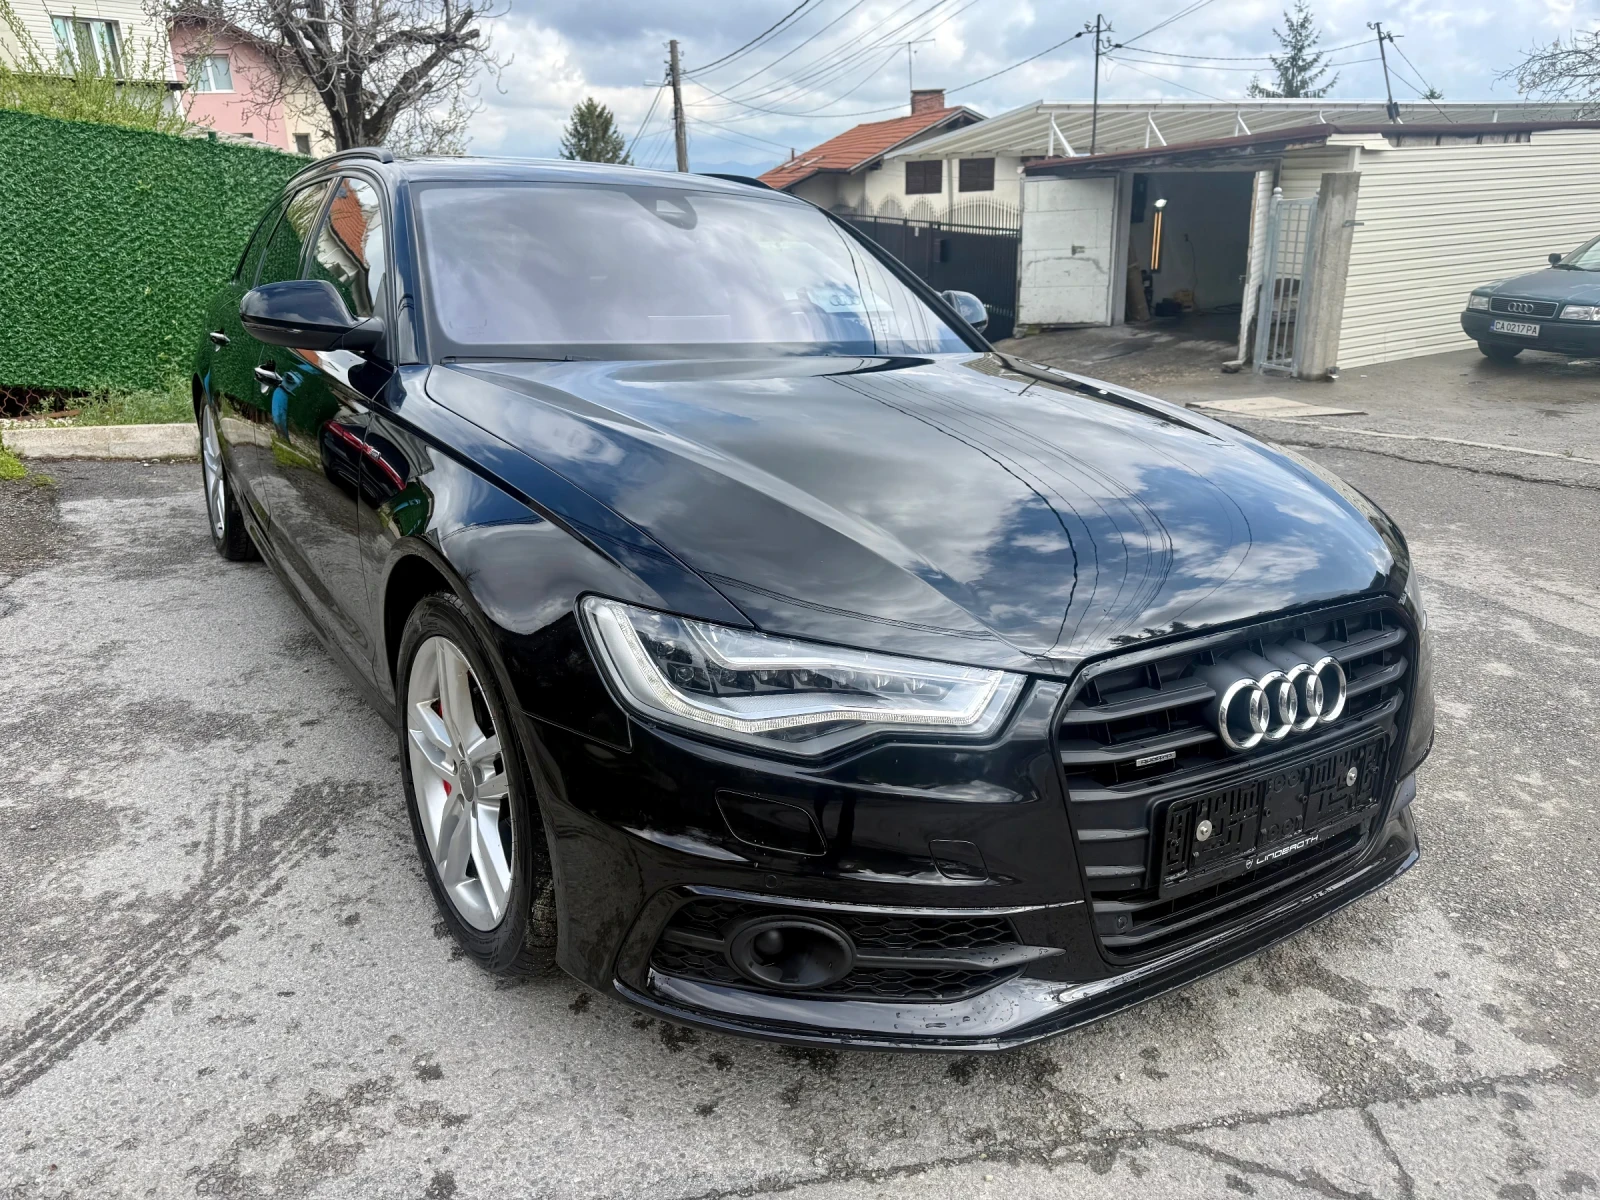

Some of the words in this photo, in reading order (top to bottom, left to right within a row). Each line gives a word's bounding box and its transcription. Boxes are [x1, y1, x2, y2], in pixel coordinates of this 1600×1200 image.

[1495, 321, 1505, 331] CA
[1506, 322, 1526, 334] 0217
[1526, 325, 1538, 335] PA
